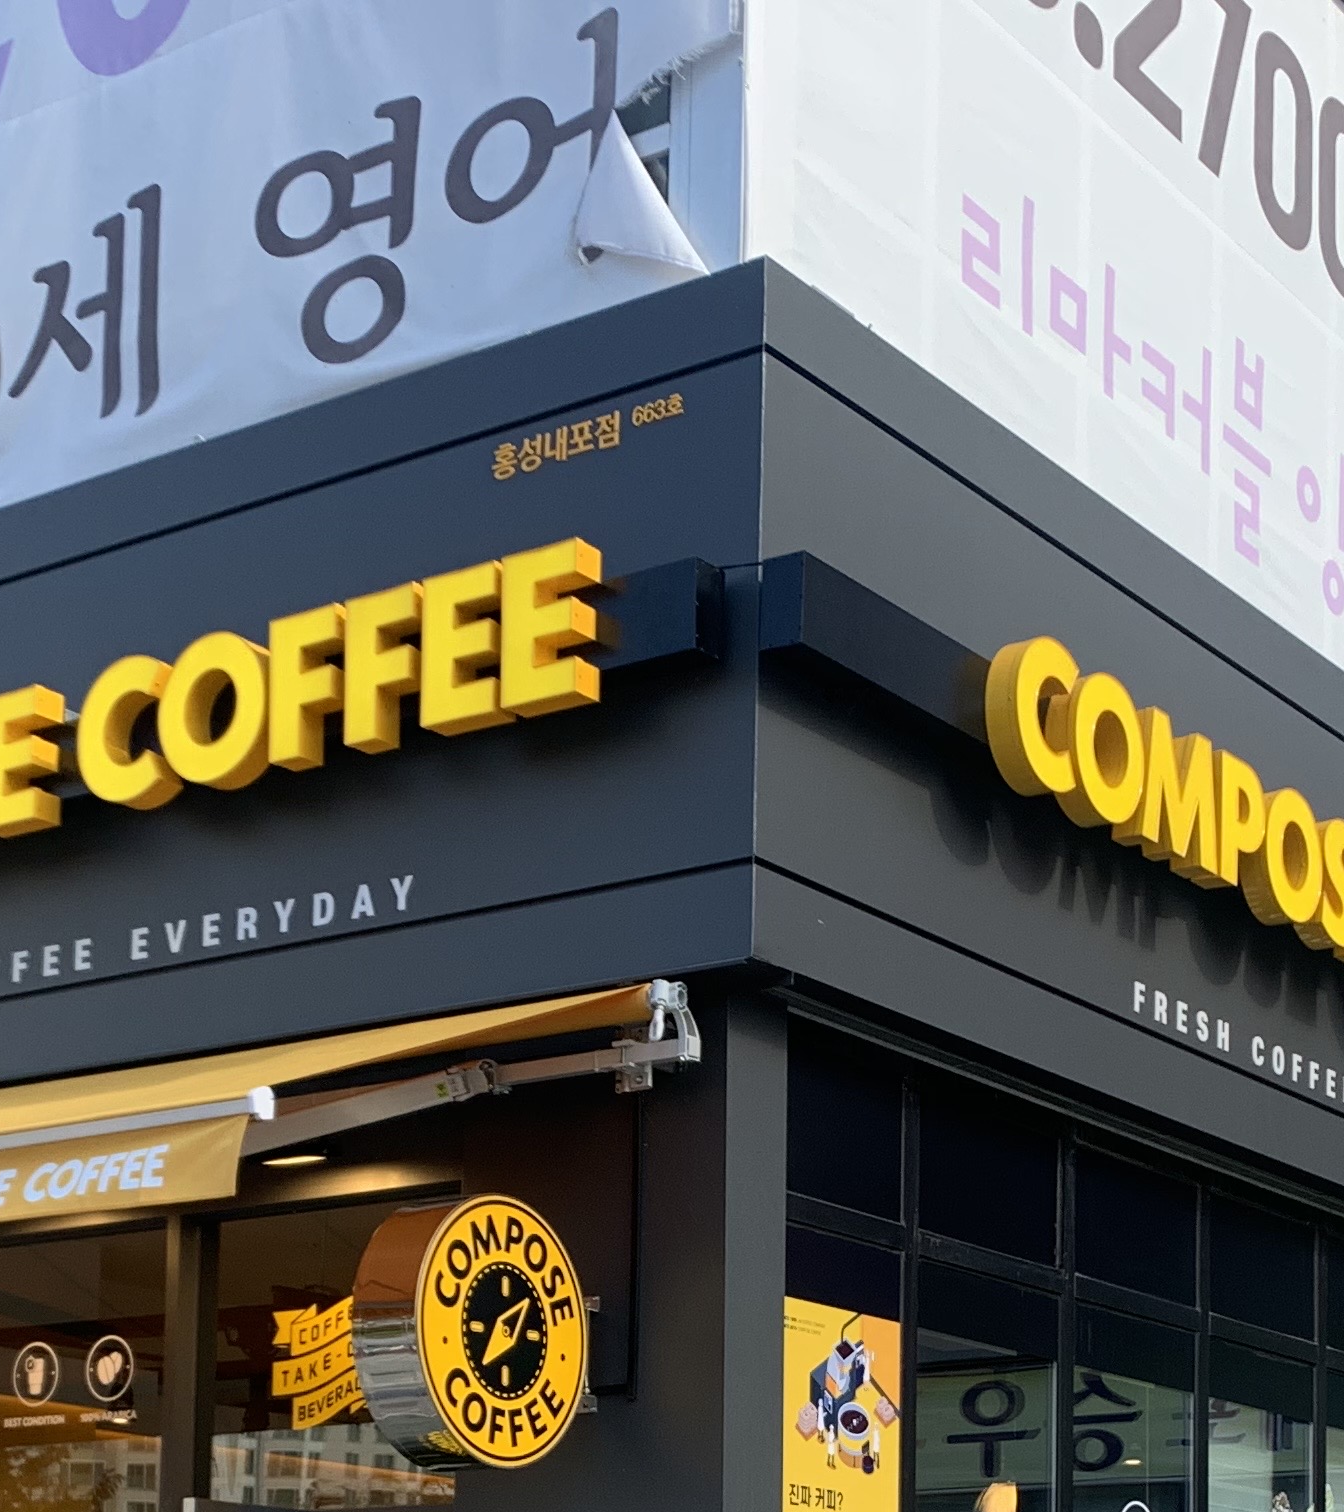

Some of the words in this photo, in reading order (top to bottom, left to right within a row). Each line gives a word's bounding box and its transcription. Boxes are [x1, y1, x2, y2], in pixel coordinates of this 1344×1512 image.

[256, 8, 619, 364] 영어
[492, 410, 621, 480] 홍성내포점
[631, 392, 684, 427] 663호
[76, 536, 603, 810] COFFEE
[130, 873, 419, 962] EVERYDAY
[1133, 981, 1231, 1054] FRESH
[22, 1143, 172, 1206] COFFEE
[434, 1214, 574, 1327] COMPOSE
[297, 1304, 354, 1346] COFFE
[3, 1417, 22, 1428] BEST
[23, 1414, 65, 1427] CONDITION
[444, 1367, 565, 1448] COFFEE
[815, 1487, 844, 1511] 커피?
